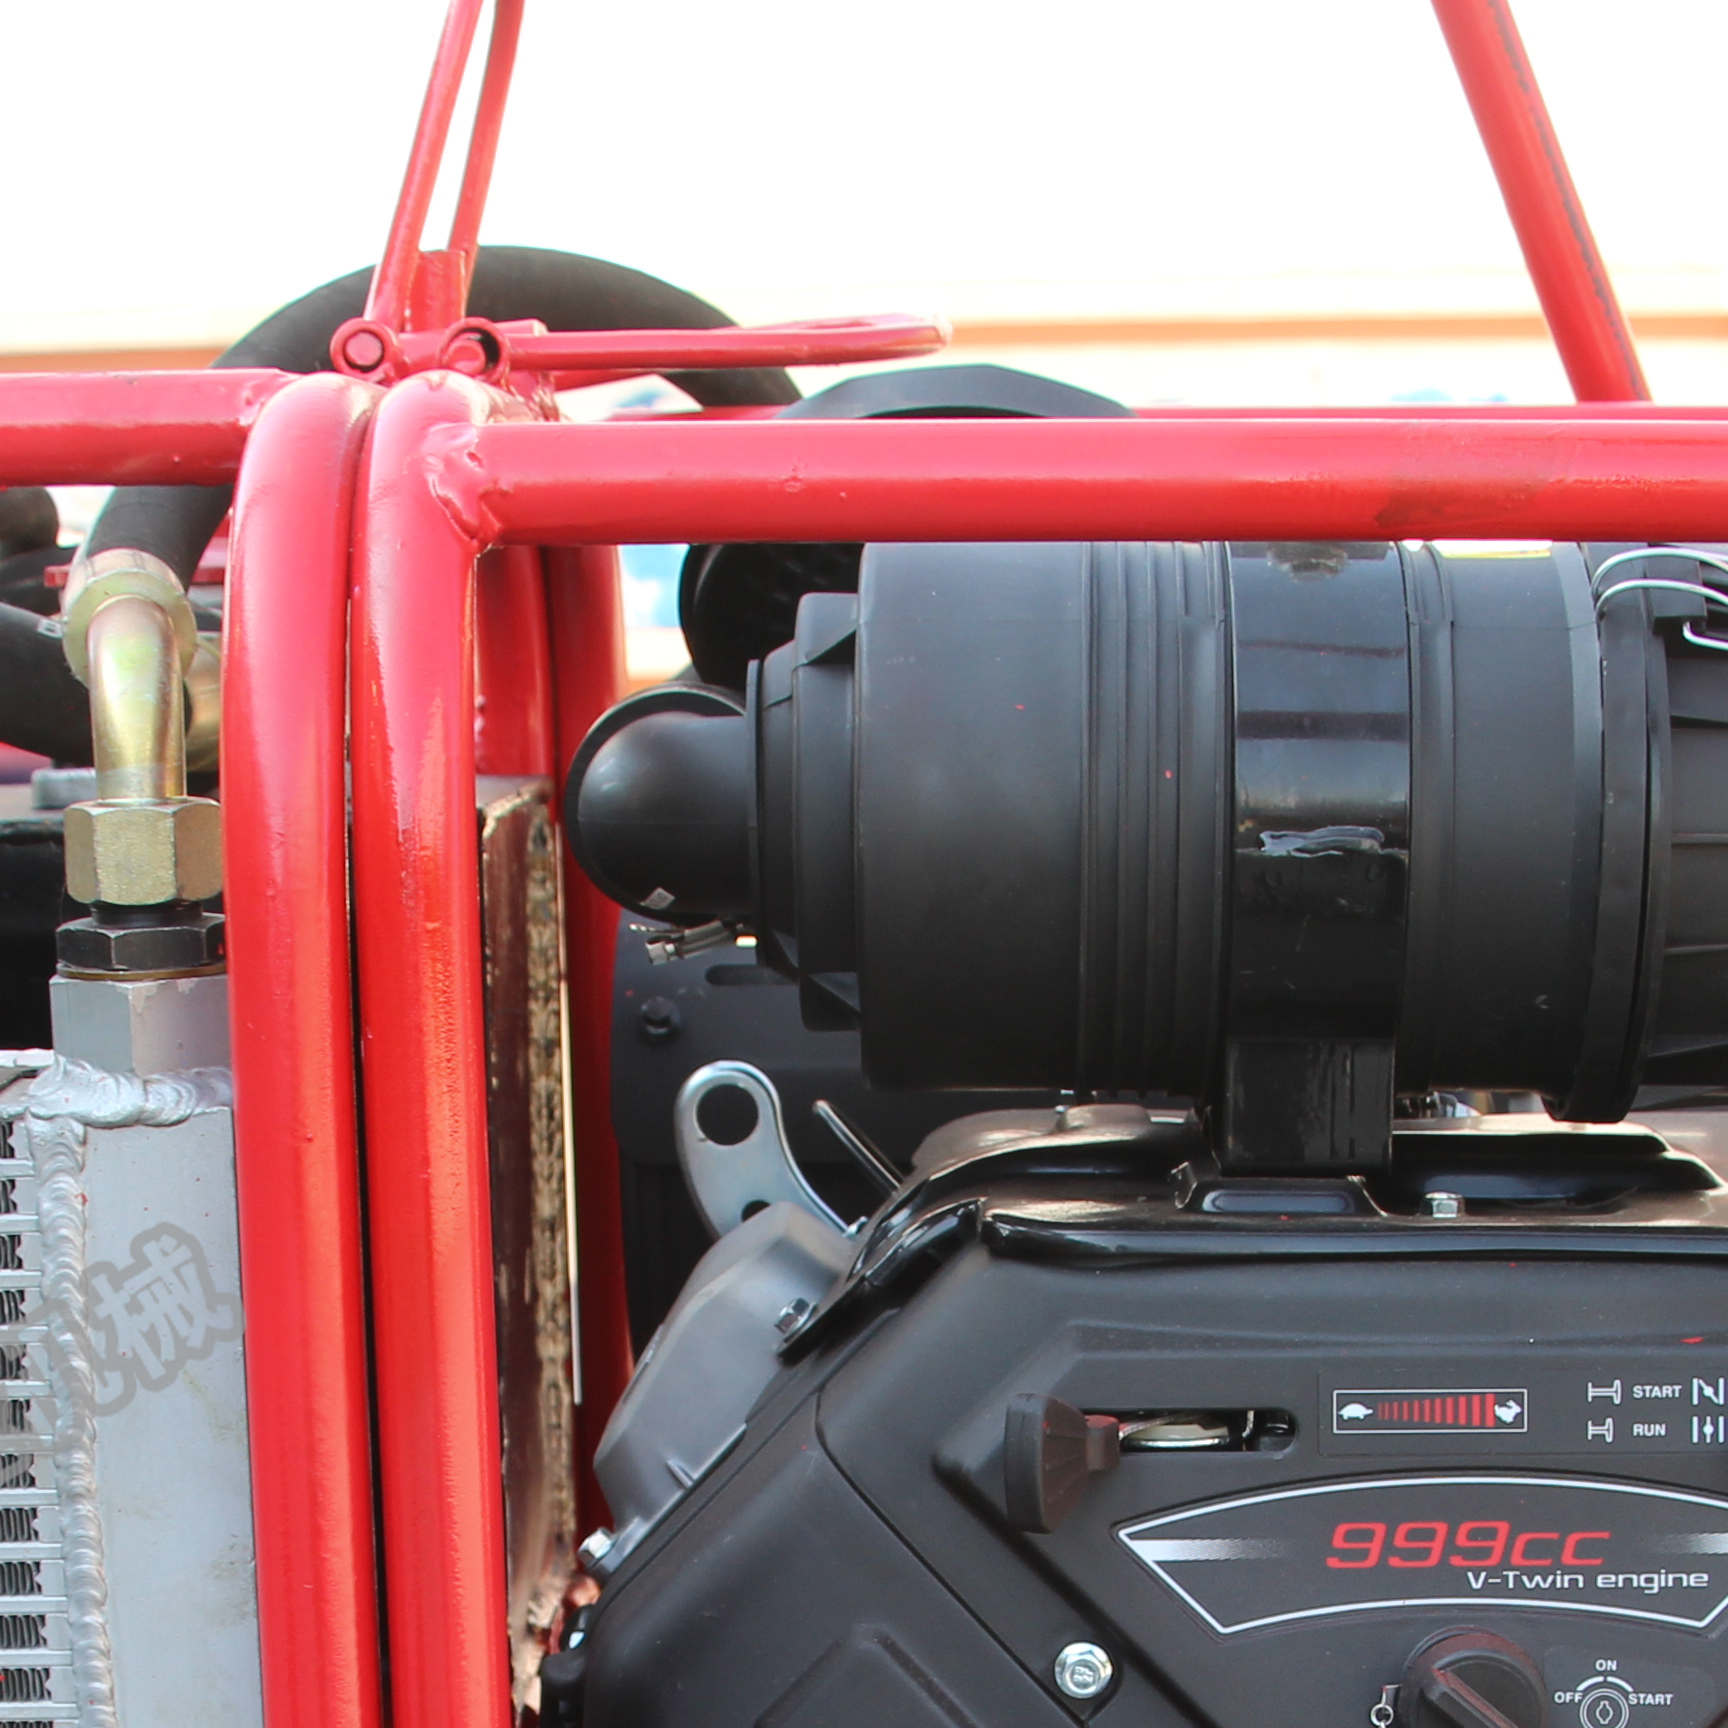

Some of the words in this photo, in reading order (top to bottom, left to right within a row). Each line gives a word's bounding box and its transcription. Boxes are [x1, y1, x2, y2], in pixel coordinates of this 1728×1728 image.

[1632, 1385, 1682, 1398] START
[1632, 1423, 1666, 1437] RUN
[1325, 1520, 1611, 1569] 999cc
[1466, 1570, 1584, 1590] V-Twin
[1596, 1568, 1709, 1594] engine
[1595, 1659, 1617, 1671] ON
[1554, 1691, 1584, 1703] OFF
[1628, 1693, 1673, 1706] START
